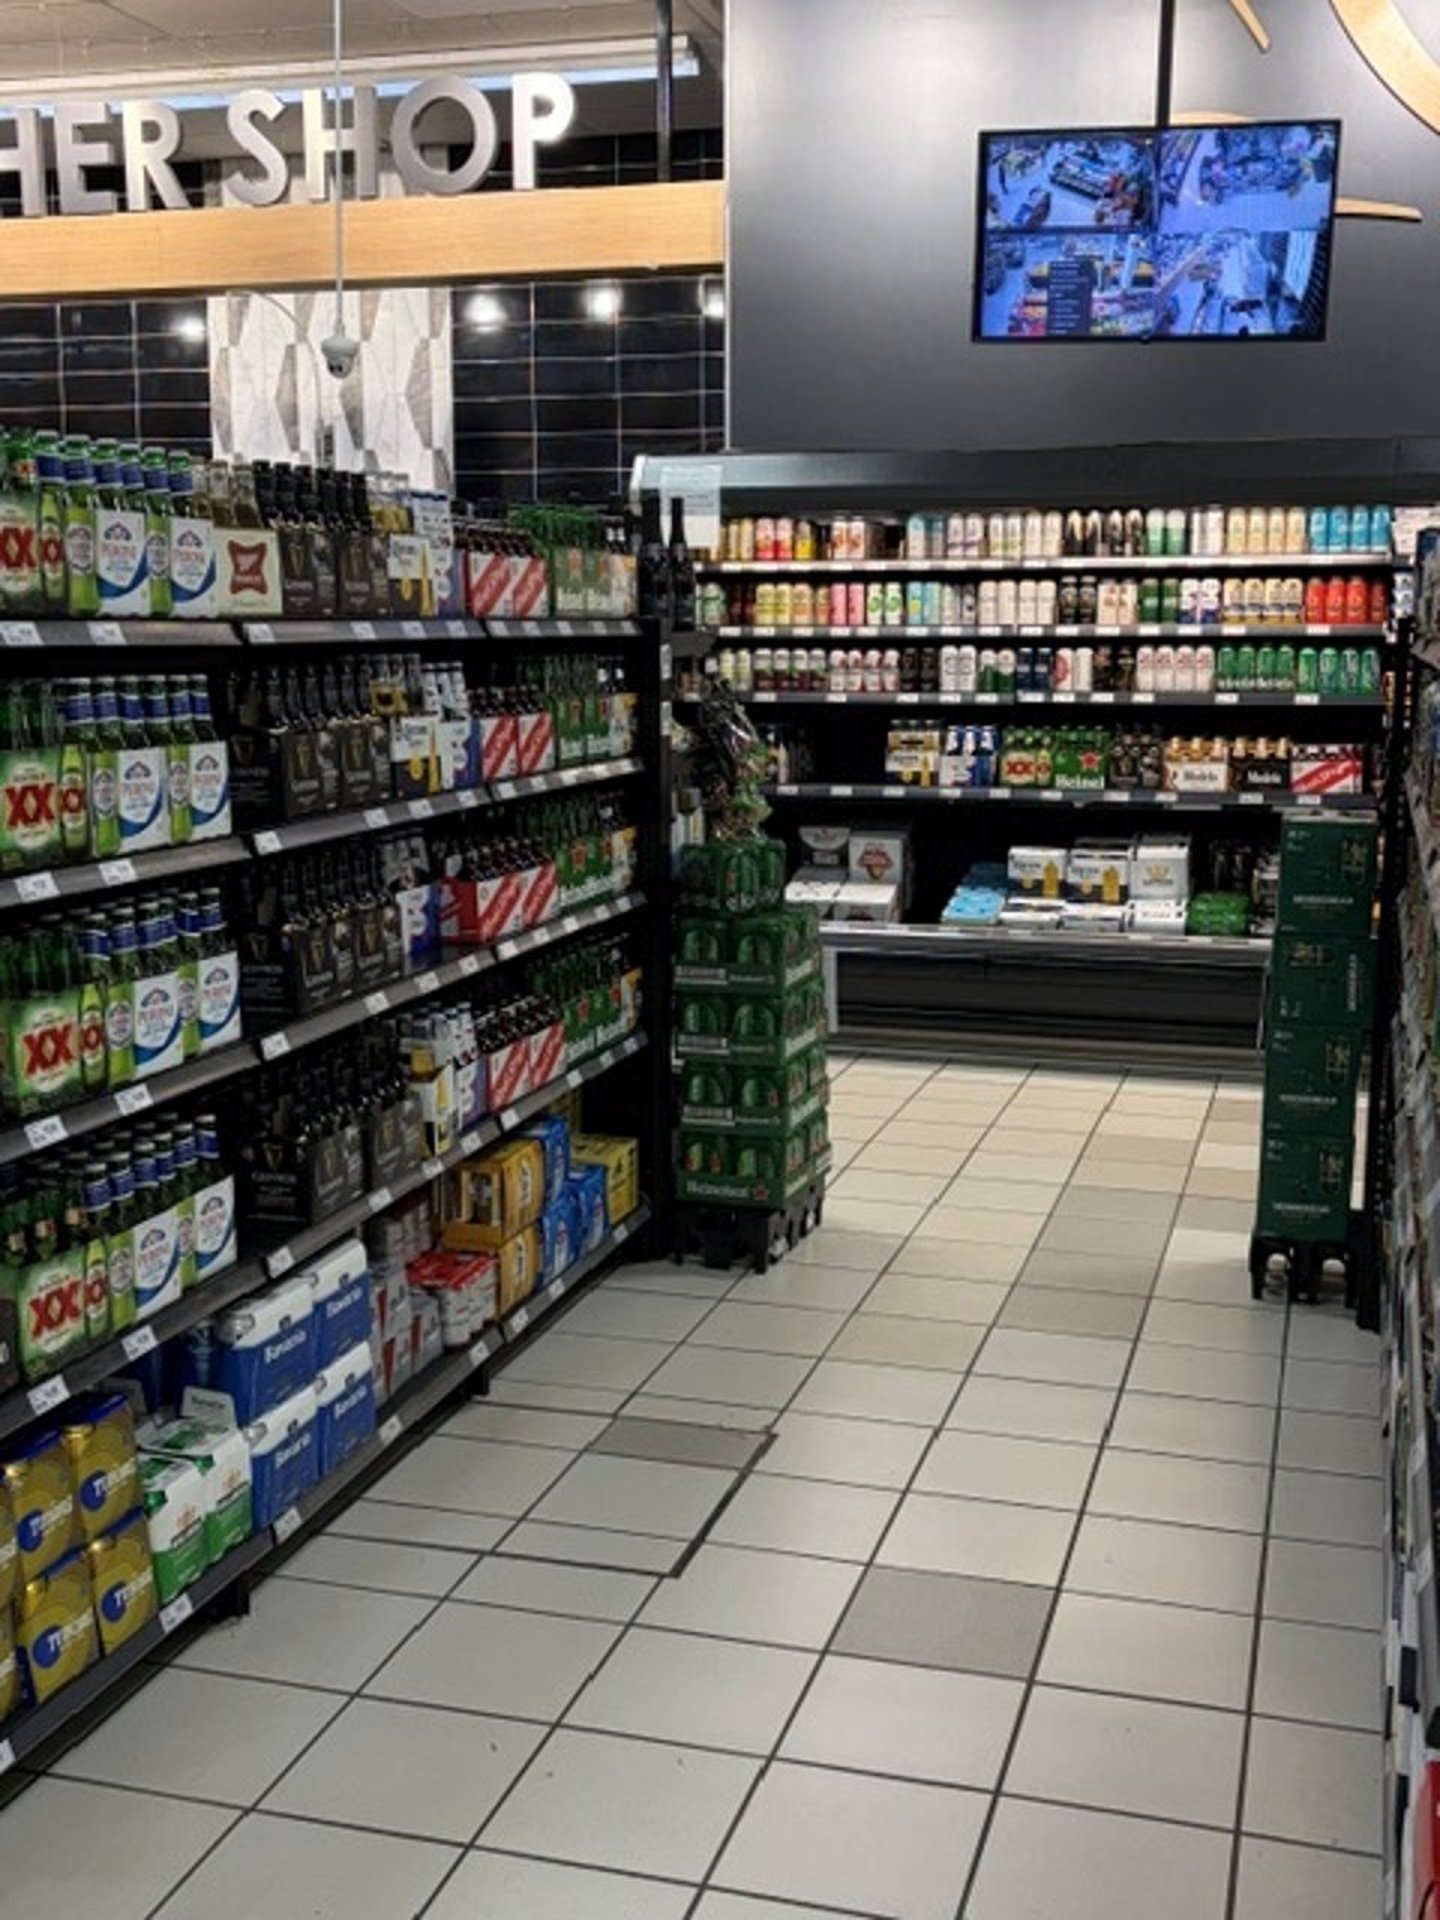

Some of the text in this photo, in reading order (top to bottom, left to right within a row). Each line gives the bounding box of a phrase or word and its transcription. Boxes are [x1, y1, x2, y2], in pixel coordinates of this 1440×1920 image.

[226, 71, 577, 207] SHOP
[5, 784, 55, 828] XX
[23, 1024, 75, 1075] XX
[28, 1279, 81, 1338] XX
